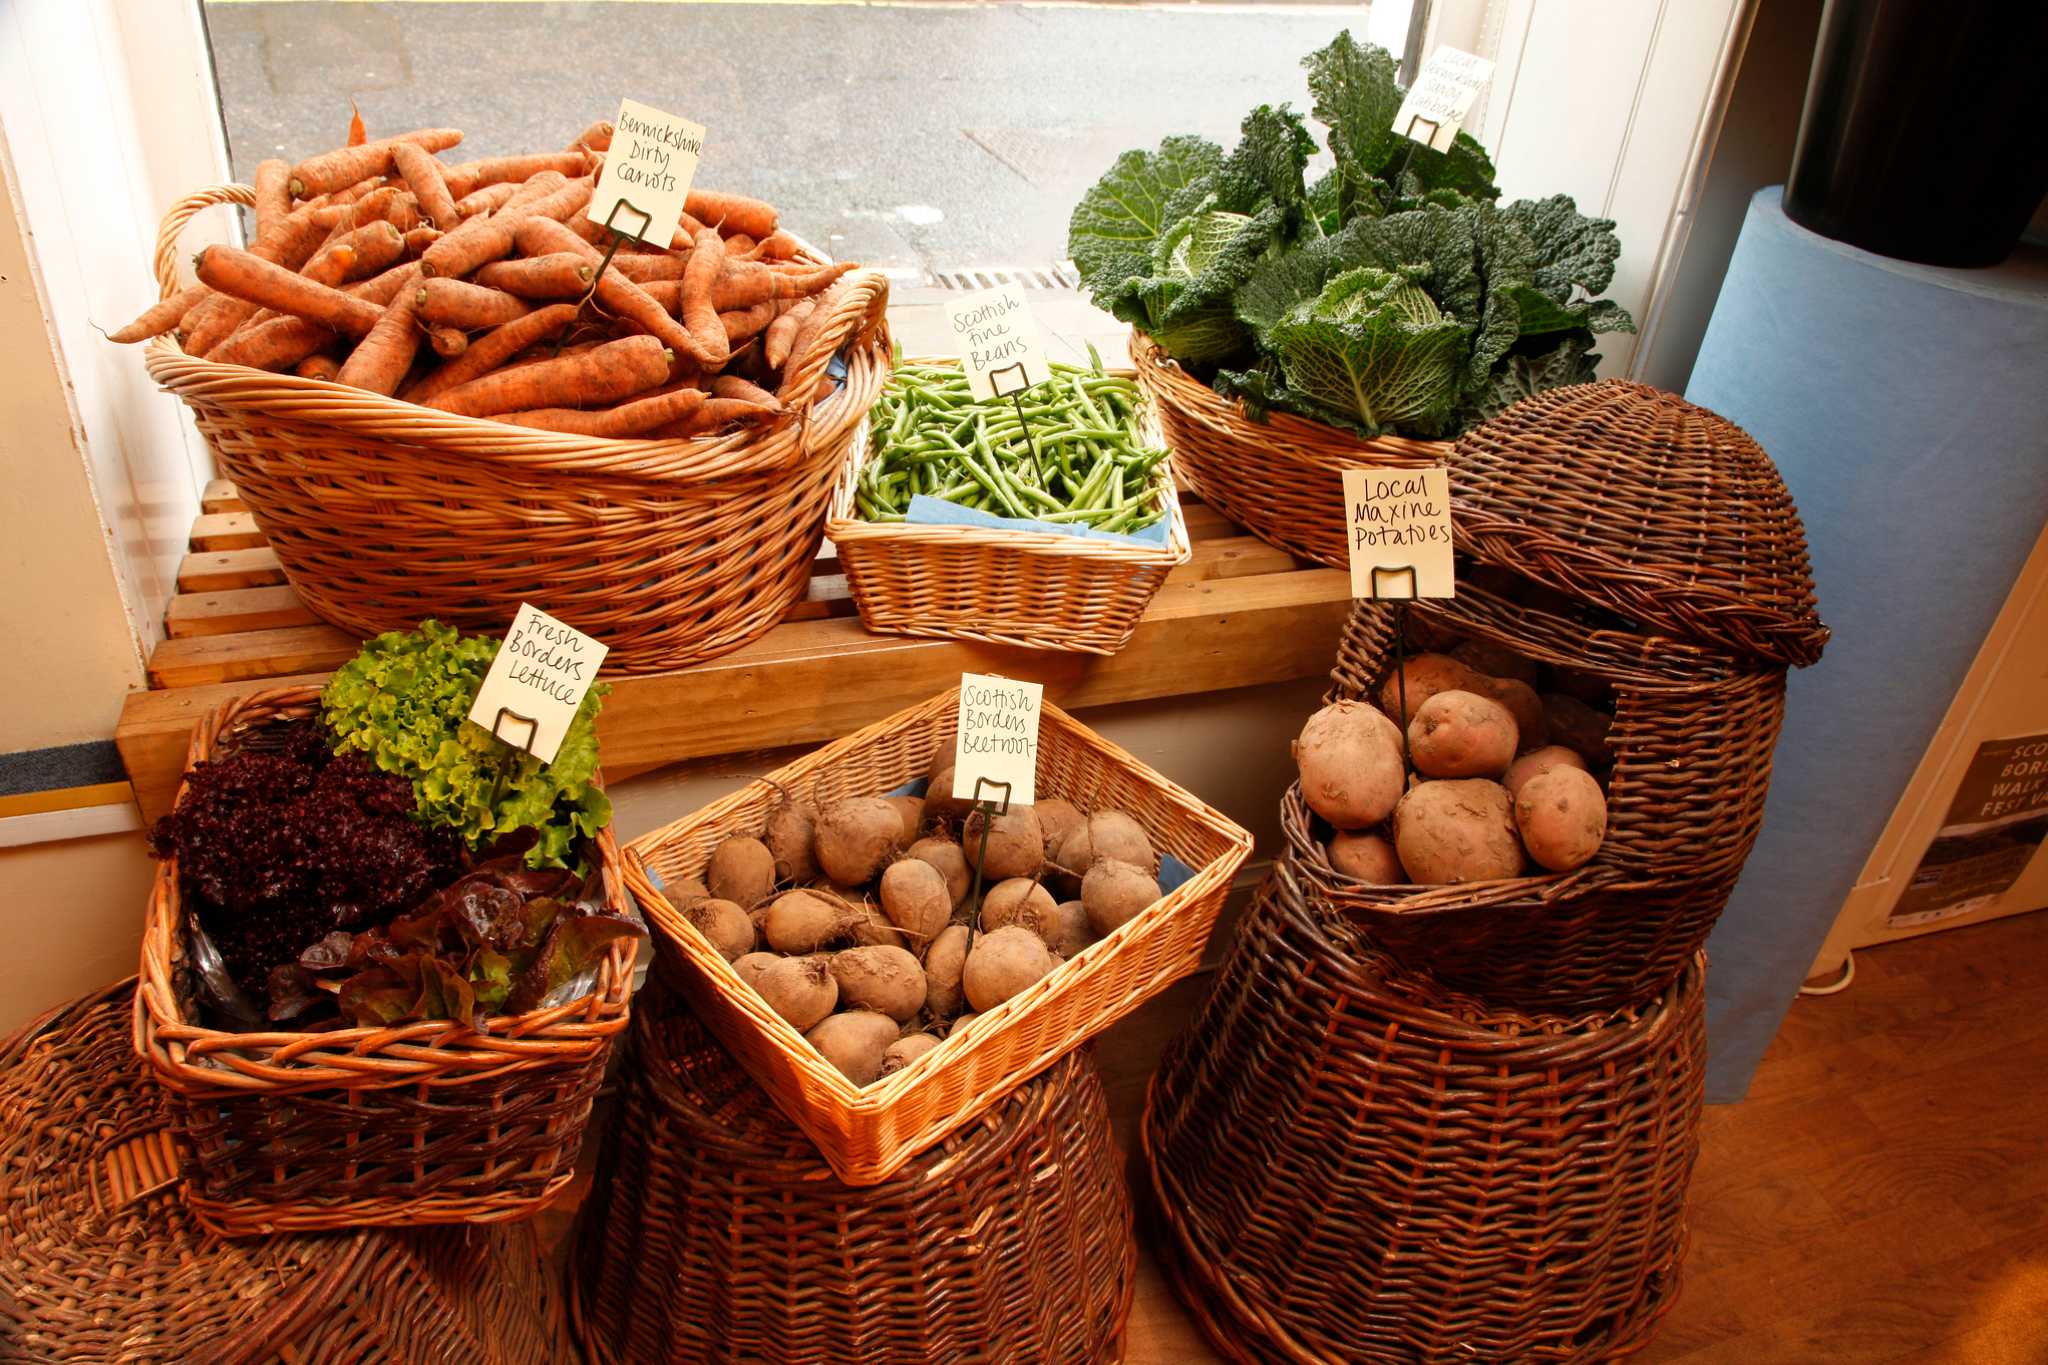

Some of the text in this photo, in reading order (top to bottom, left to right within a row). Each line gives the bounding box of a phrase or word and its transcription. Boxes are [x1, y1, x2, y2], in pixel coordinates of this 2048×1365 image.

[630, 140, 670, 176] Dirty
[617, 162, 676, 192] Carrots
[954, 294, 1020, 333] Scottish
[970, 336, 1028, 371] Beans
[1364, 474, 1428, 502] Local
[1354, 500, 1441, 526] Maxine
[1355, 523, 1450, 551] Potatoes
[527, 614, 584, 653] Fresh
[509, 630, 585, 681] Borders
[508, 659, 577, 705] Lettuce
[963, 685, 1034, 712] Scottish
[966, 708, 1026, 734] Borders
[962, 732, 1037, 758] Beetroot
